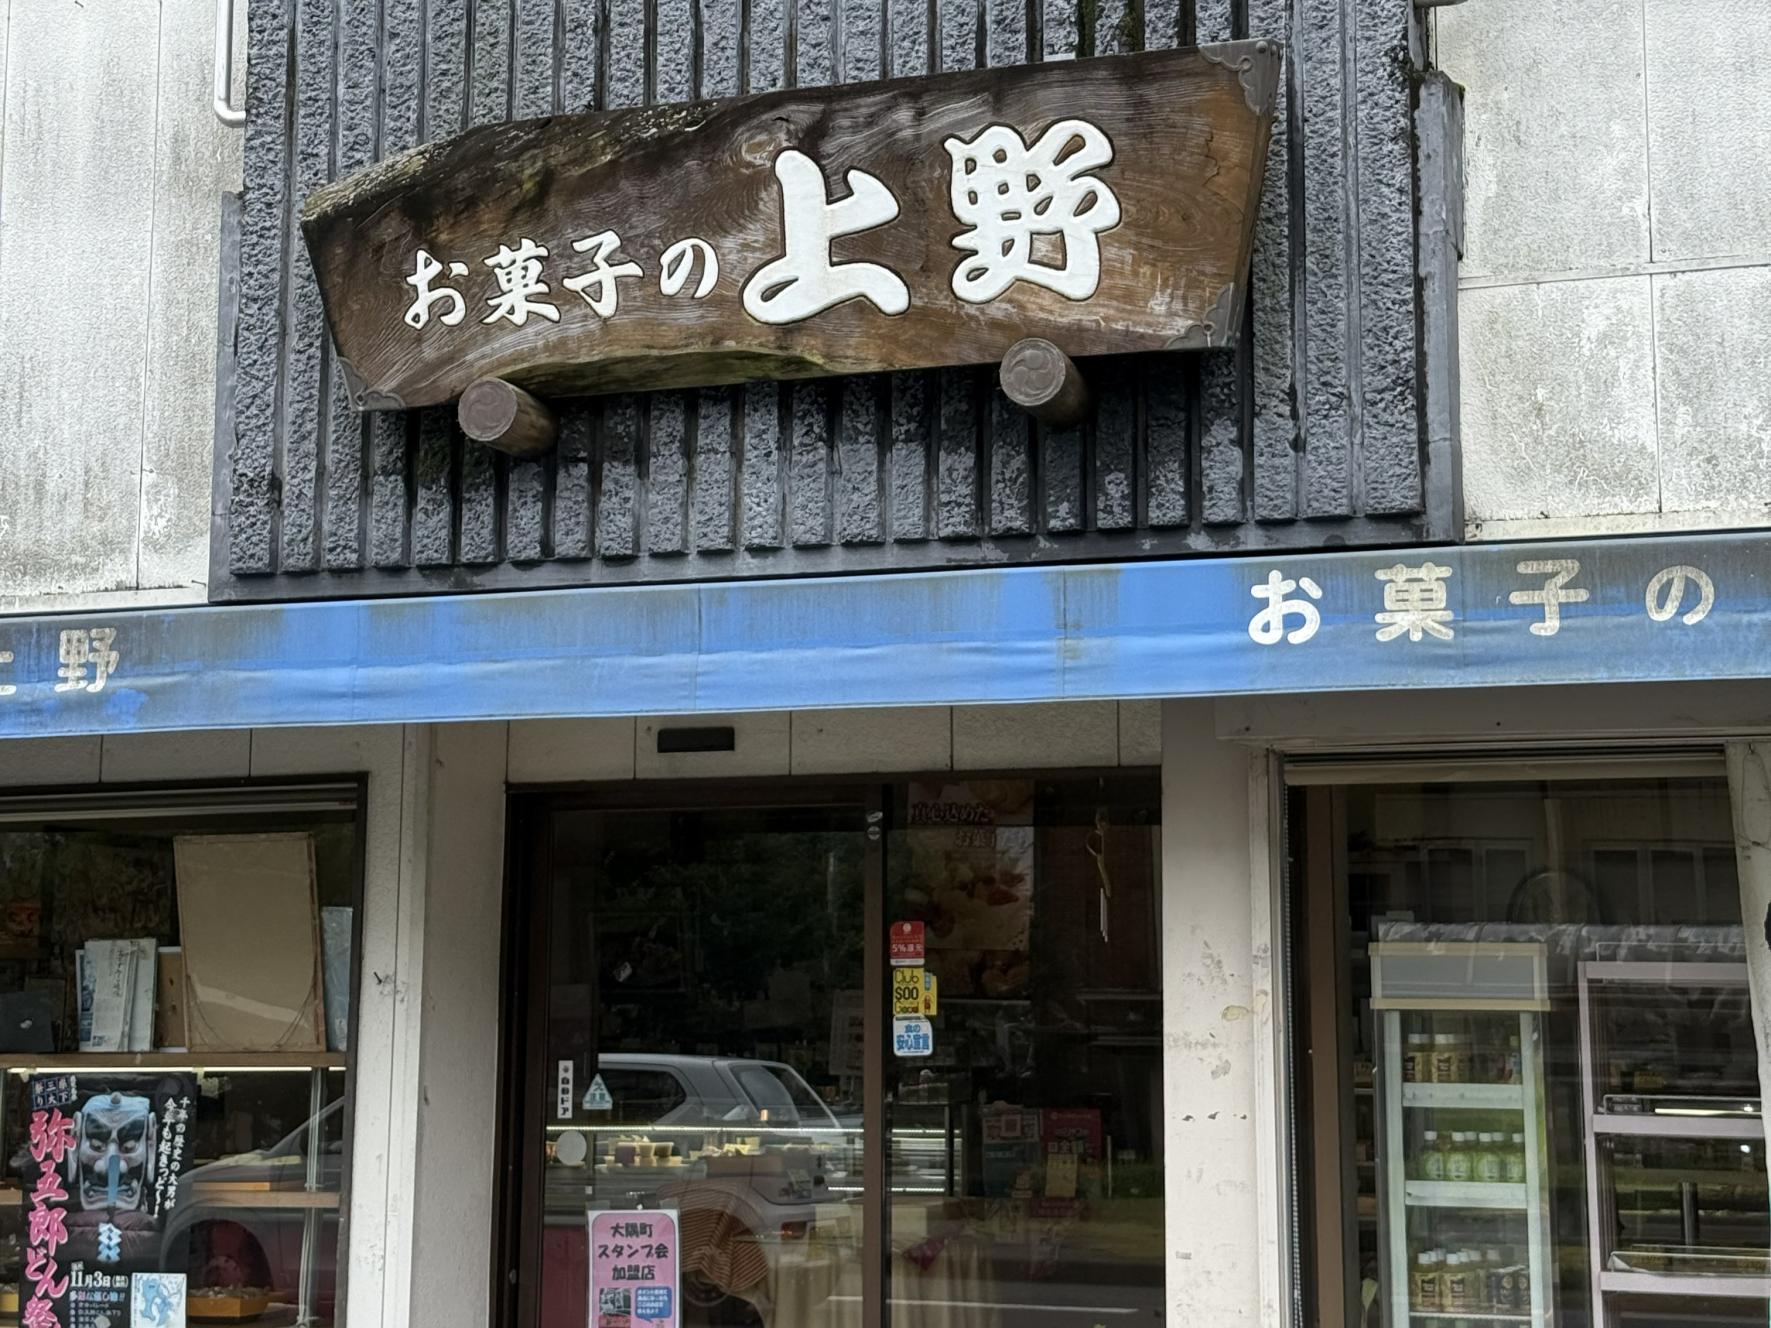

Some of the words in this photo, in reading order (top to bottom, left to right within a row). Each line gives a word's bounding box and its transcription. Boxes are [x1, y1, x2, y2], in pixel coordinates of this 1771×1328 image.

[404, 229, 719, 331] お菓子の
[743, 119, 1121, 324] 上野
[1248, 558, 1715, 645] お菓子の
[610, 1222, 653, 1238] 大隅町
[597, 1243, 669, 1259] スタンプ会
[612, 1264, 656, 1281] 加盟店
